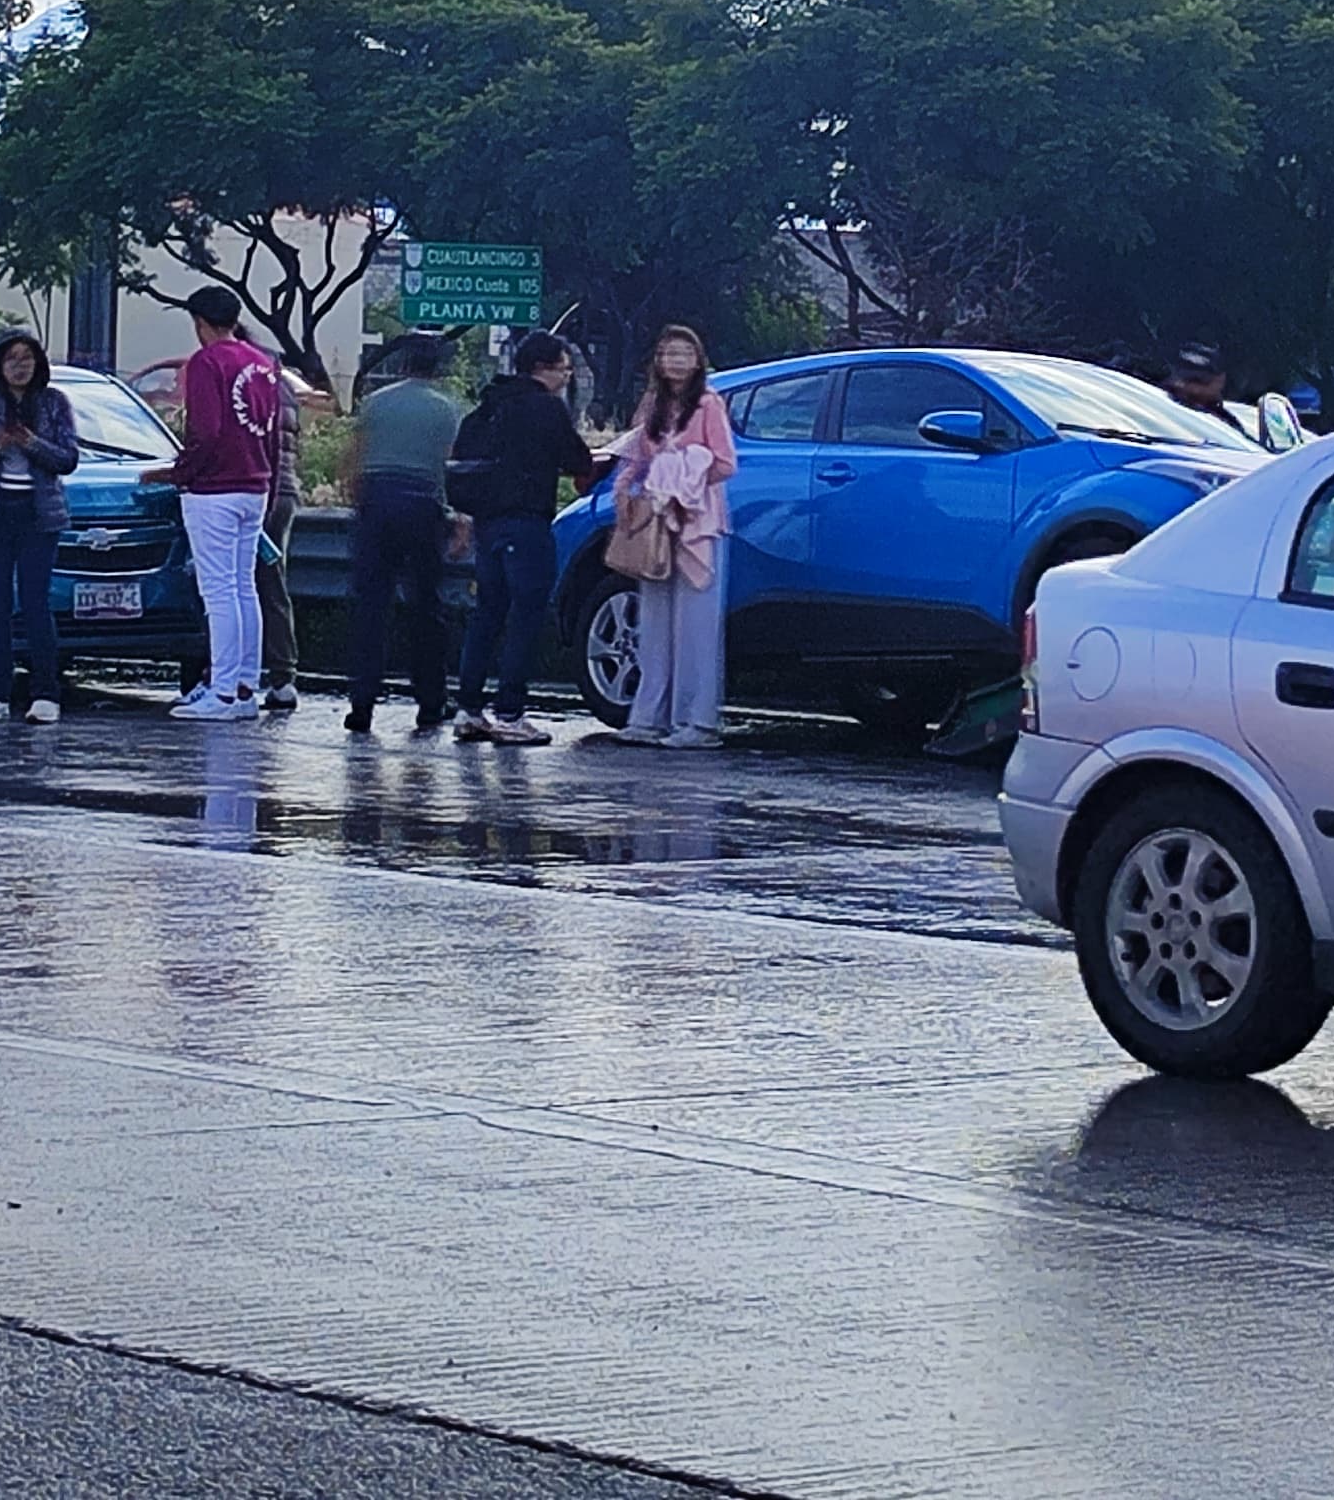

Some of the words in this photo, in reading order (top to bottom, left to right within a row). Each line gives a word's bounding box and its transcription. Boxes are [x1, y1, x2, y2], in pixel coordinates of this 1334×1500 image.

[531, 251, 540, 268] 3
[518, 278, 540, 295] 105
[419, 302, 486, 320] PLANTA
[490, 303, 516, 319] VW
[529, 306, 540, 321] 8
